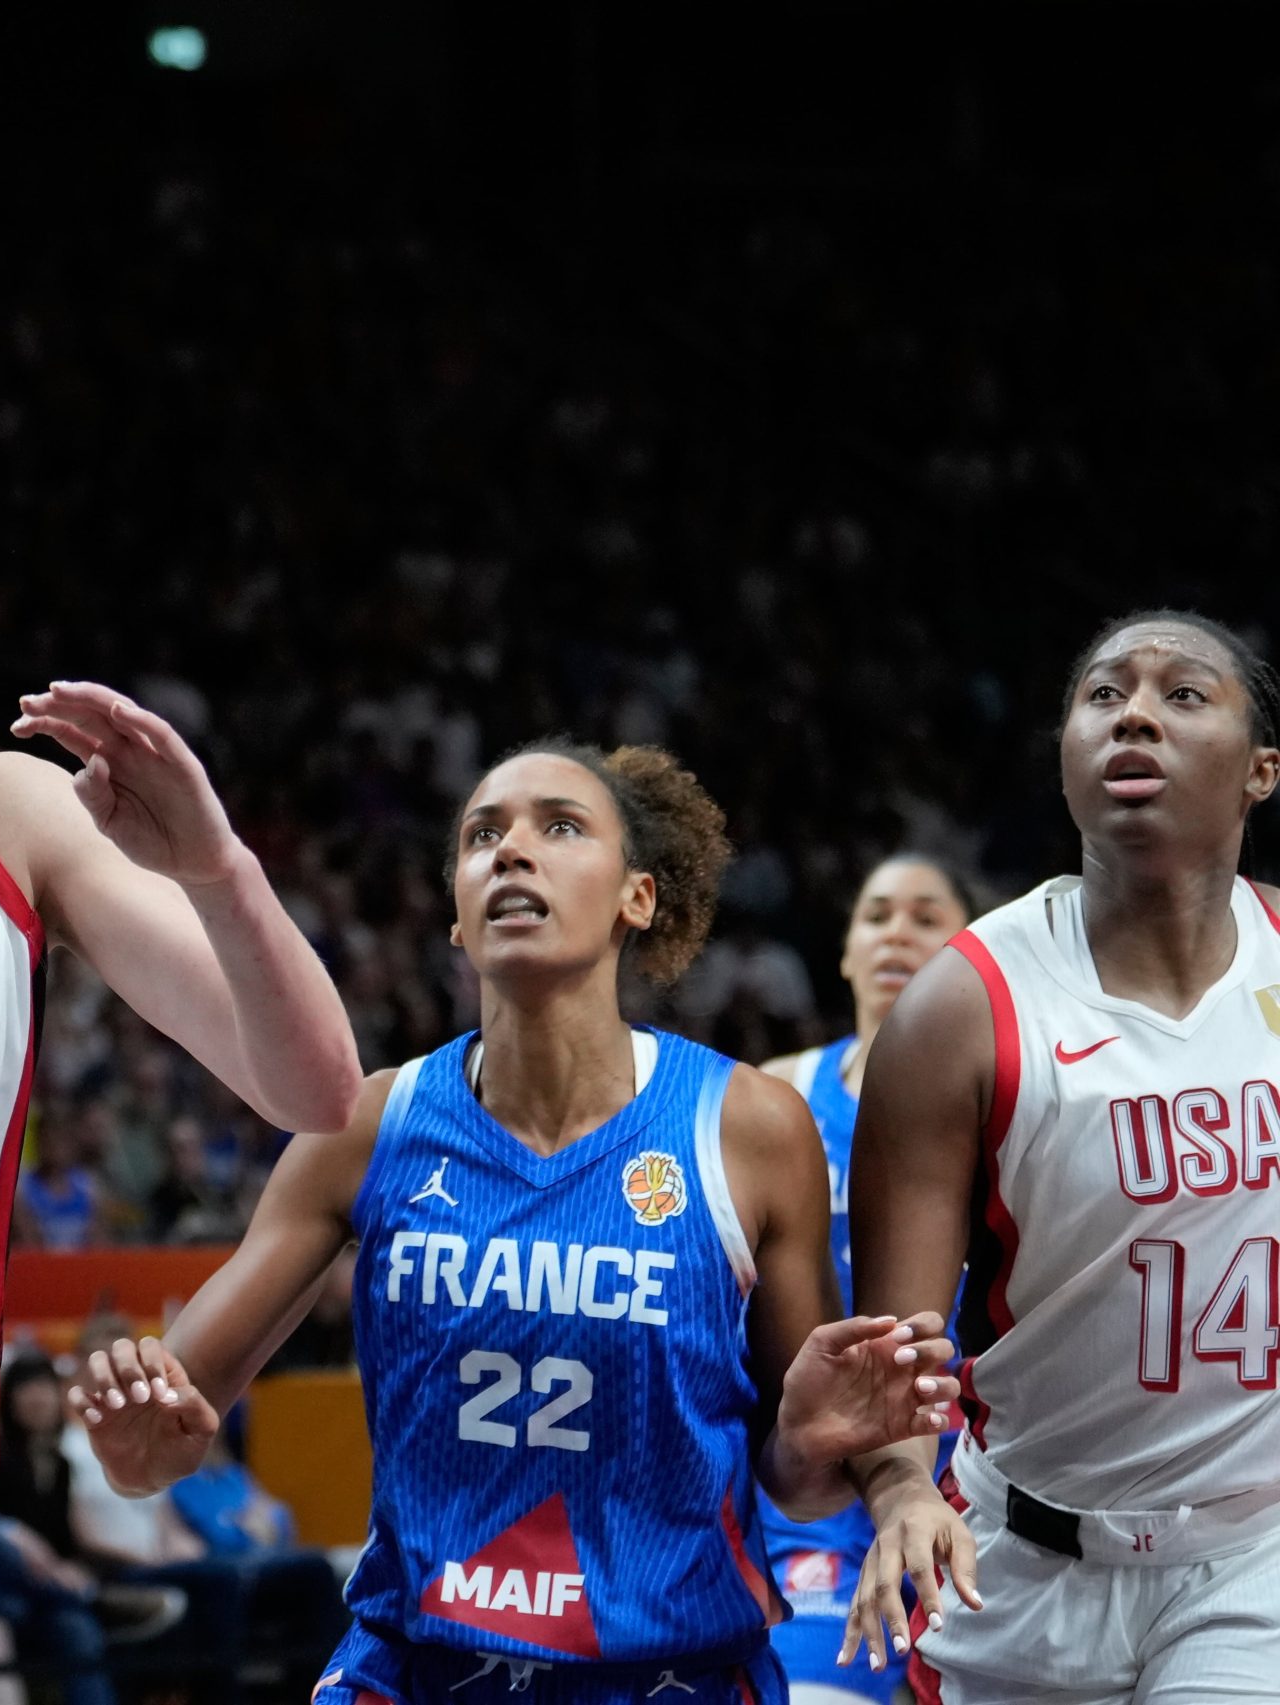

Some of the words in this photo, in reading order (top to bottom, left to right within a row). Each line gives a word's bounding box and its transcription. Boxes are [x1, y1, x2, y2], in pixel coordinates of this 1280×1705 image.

[1110, 1080, 1280, 1205] USA
[387, 1231, 675, 1326] FRANCE
[1129, 1237, 1280, 1393] 14
[458, 1349, 594, 1452] 22
[440, 1560, 585, 1617] MAIF
